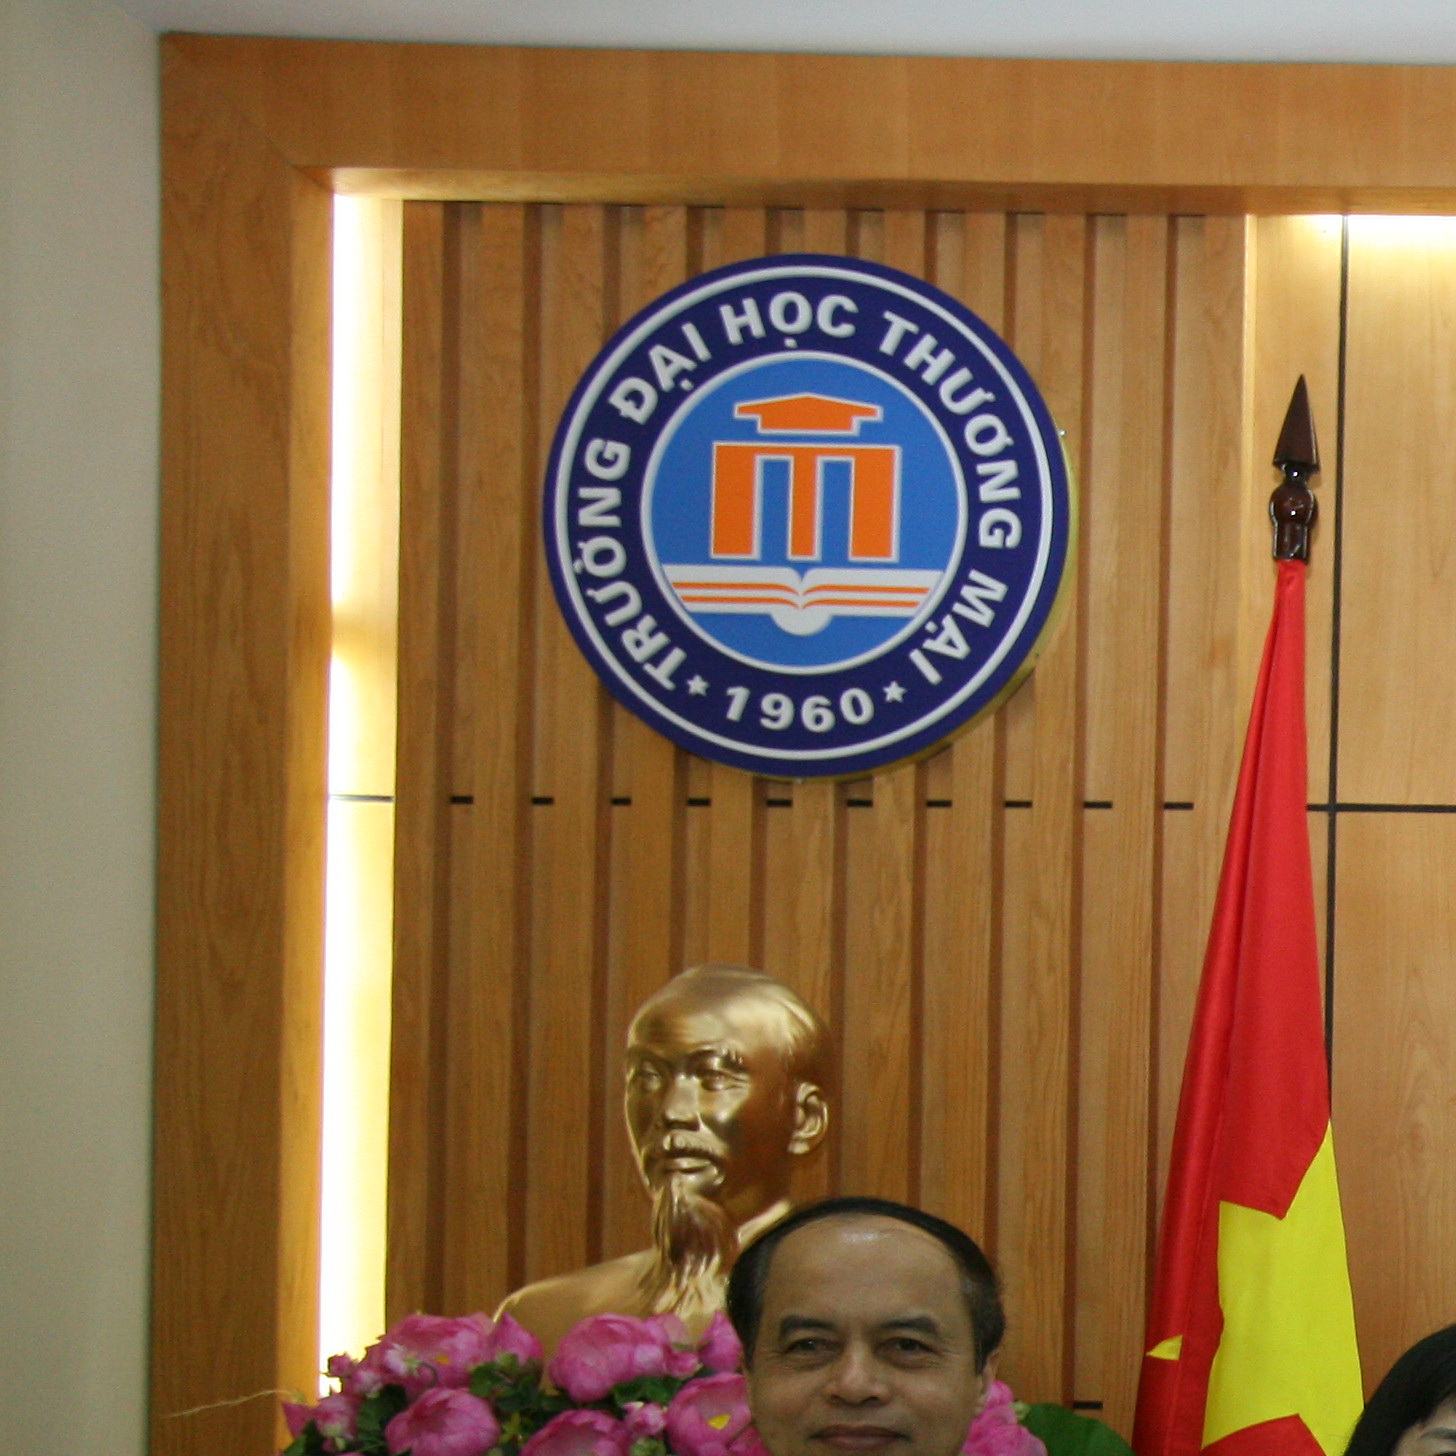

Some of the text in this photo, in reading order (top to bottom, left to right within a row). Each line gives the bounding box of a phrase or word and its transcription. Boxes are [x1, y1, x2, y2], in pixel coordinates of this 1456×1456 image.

[573, 291, 1023, 691] TRƯỜNG ĐẠI HỌC THƯƠNG MẠI
[724, 685, 876, 732] 1960
